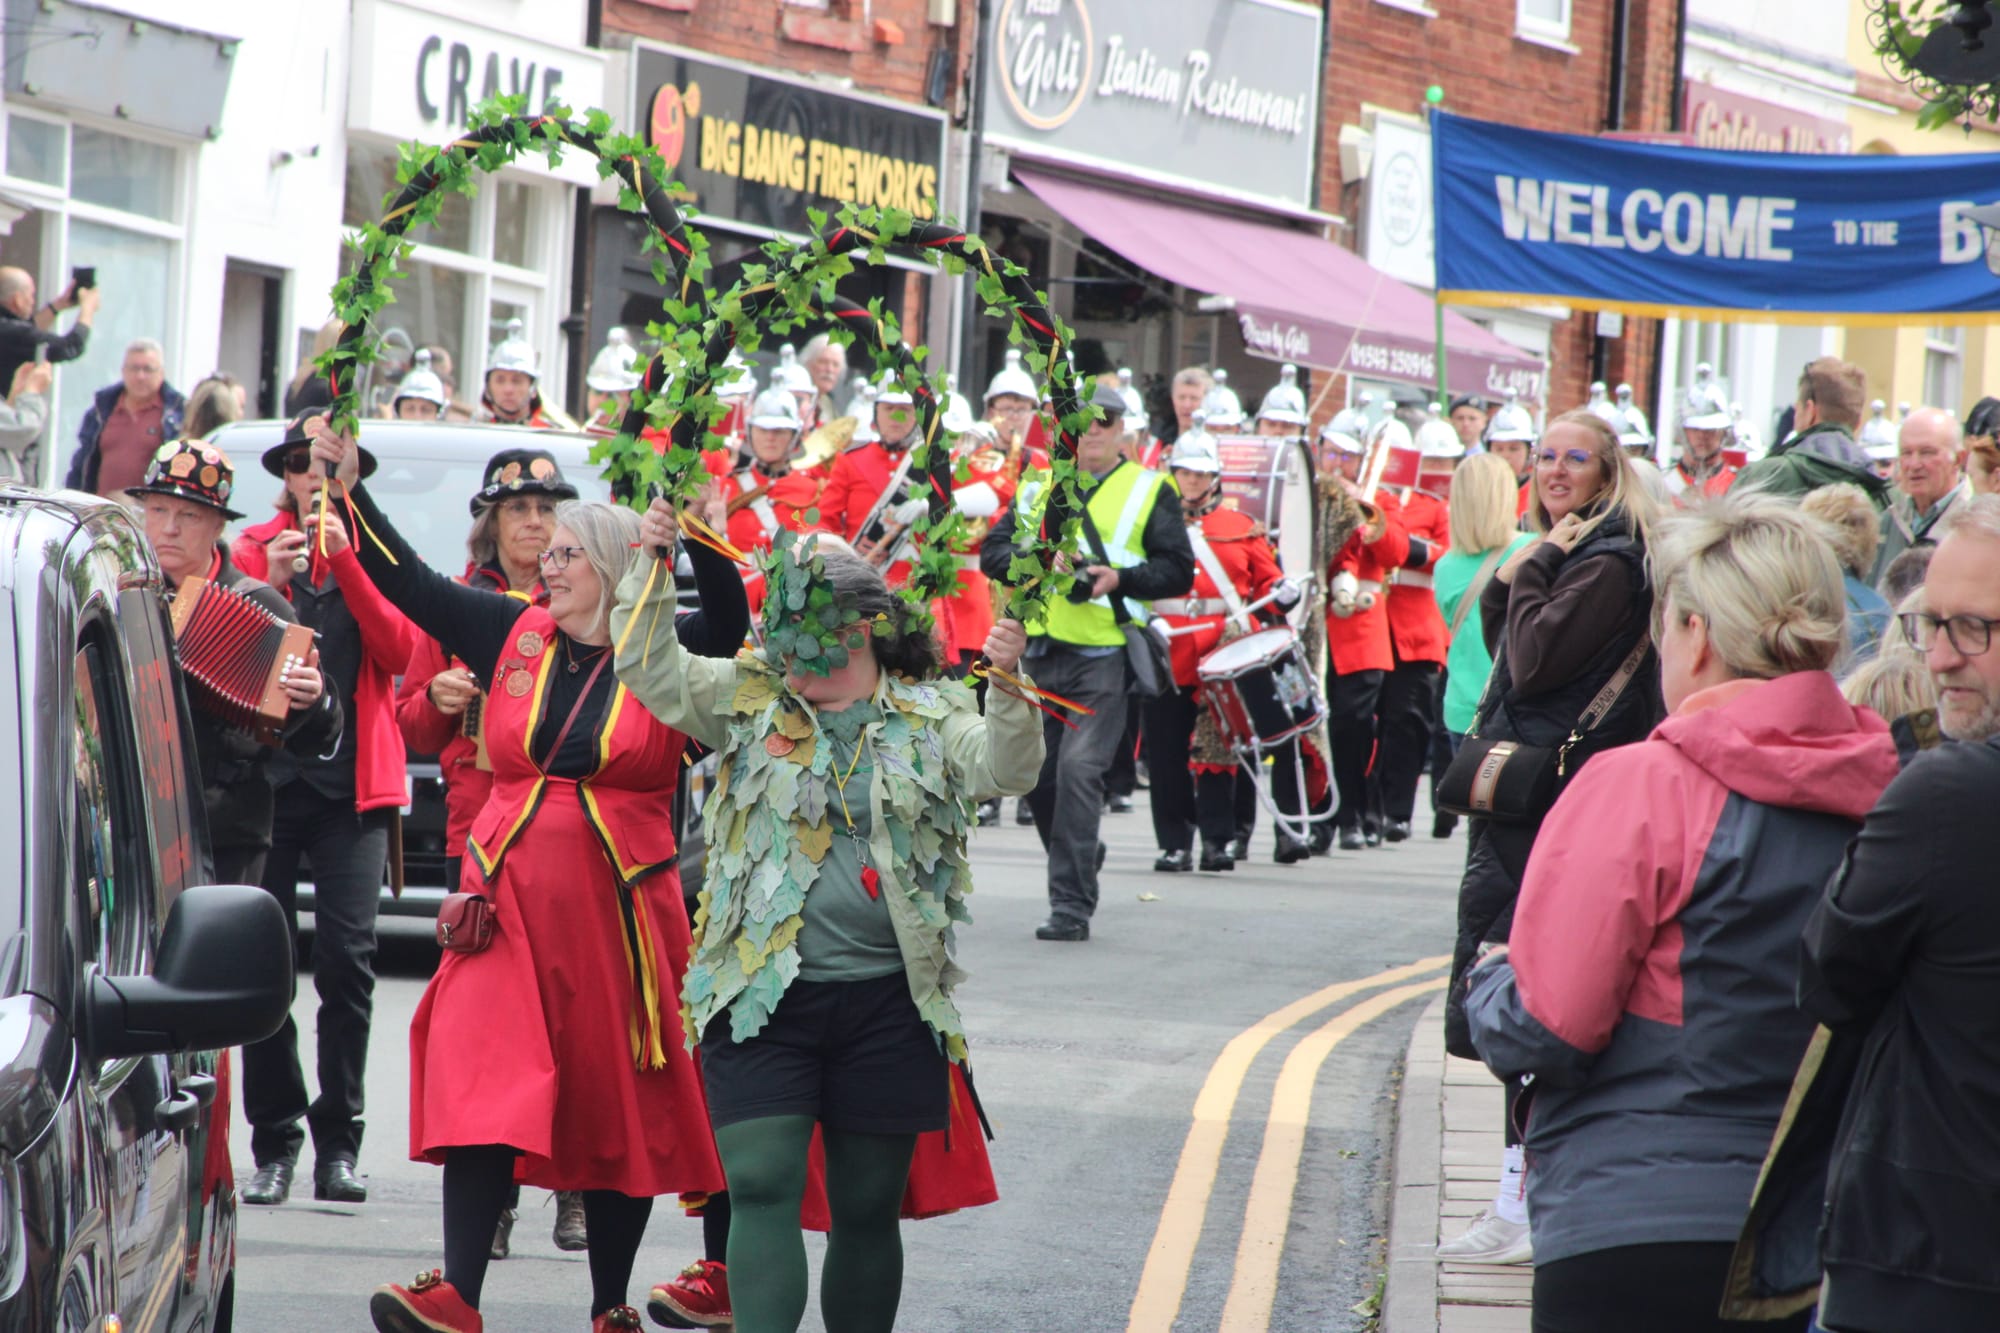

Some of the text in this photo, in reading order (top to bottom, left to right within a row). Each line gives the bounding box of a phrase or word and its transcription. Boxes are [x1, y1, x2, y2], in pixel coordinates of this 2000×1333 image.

[415, 34, 563, 129] CRAVE
[1014, 21, 1080, 108] Goli
[1098, 35, 1307, 135] Italian Restaurant
[701, 114, 938, 221] BIG BANG FIREWORKS
[1495, 174, 1797, 262] WELCOME
[1832, 219, 1858, 245] TO
[1860, 220, 1899, 246] THE
